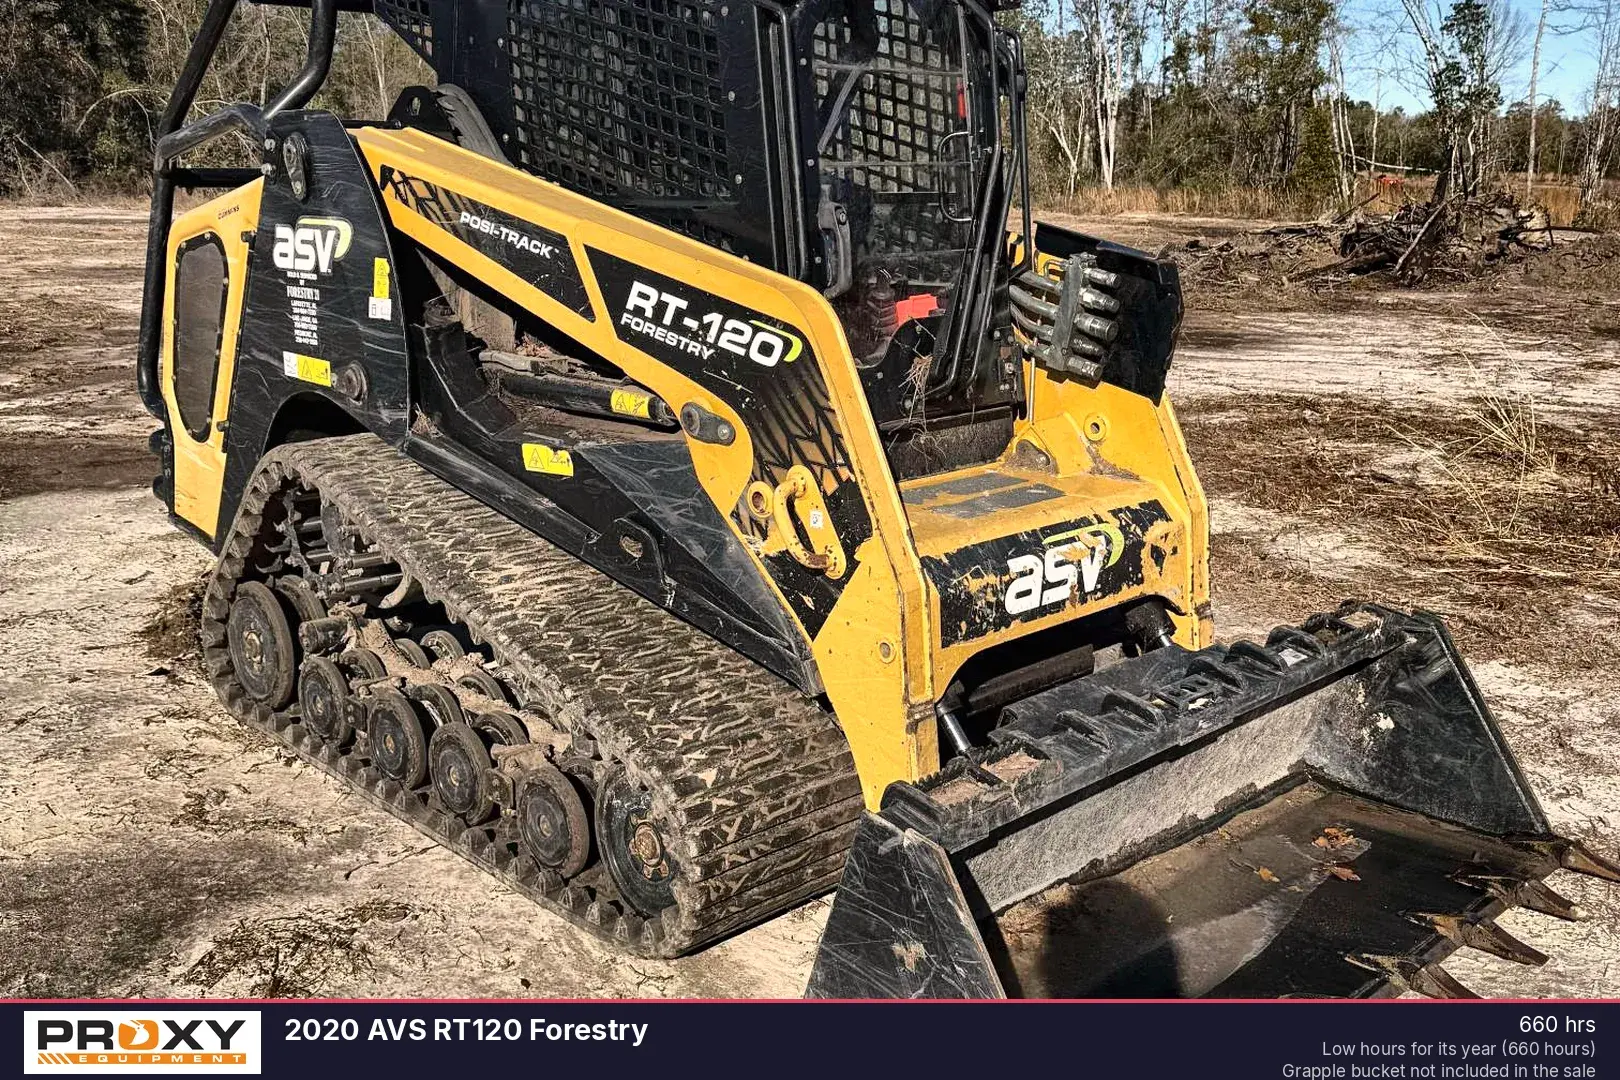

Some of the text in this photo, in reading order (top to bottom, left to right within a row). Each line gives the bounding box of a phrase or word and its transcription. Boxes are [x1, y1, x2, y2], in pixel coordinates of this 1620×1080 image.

[459, 211, 552, 260] POSI-TRACK
[620, 312, 717, 360] FORESTRY
[625, 280, 784, 368] RT-120
